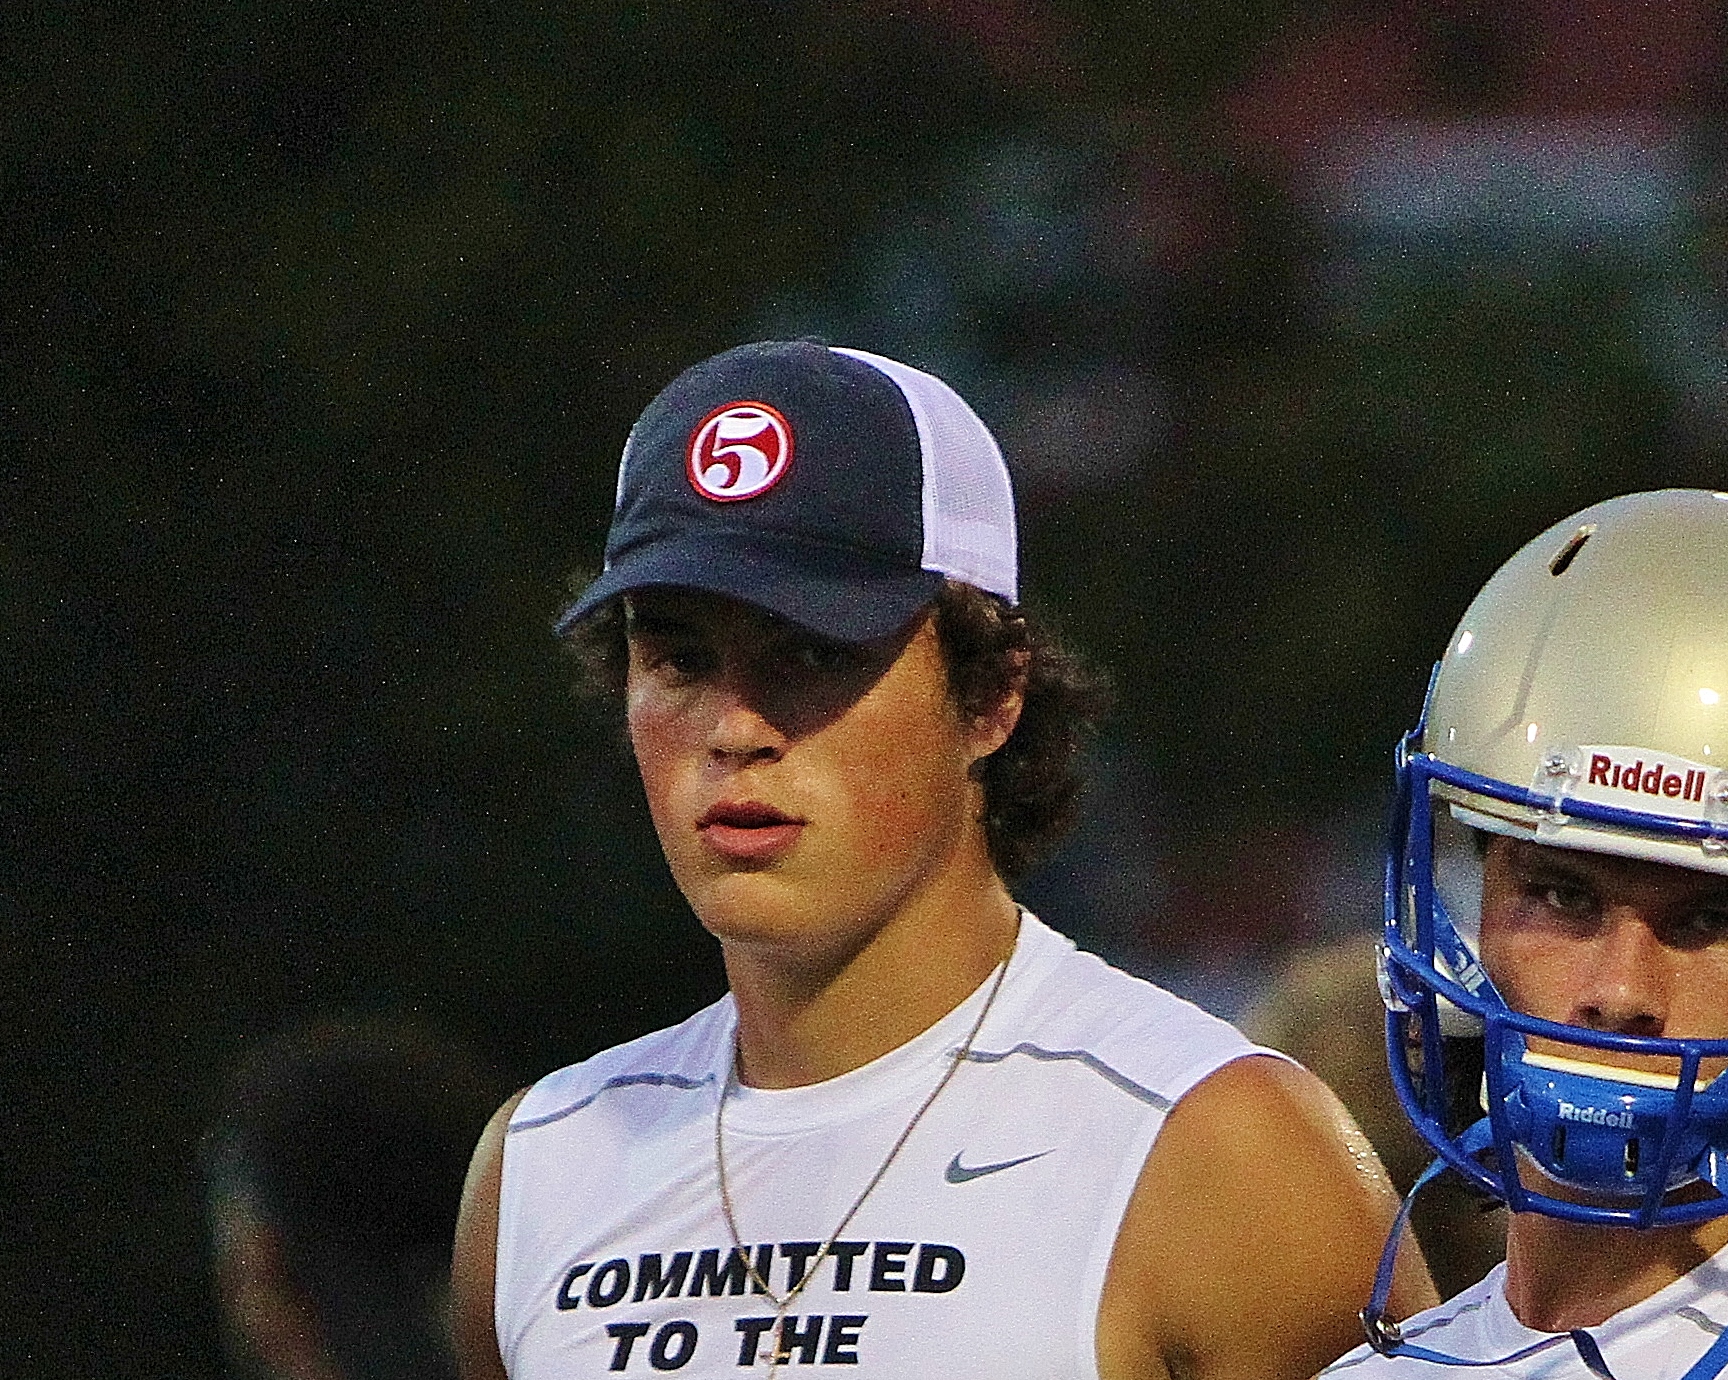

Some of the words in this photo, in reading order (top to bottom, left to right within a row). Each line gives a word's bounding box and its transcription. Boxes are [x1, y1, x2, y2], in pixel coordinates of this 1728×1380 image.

[703, 414, 771, 492] 5
[1588, 753, 1706, 802] Riddell
[1558, 1101, 1635, 1129] Riddell
[556, 1241, 966, 1310] COMMITTED
[605, 1320, 699, 1372] TO
[734, 1314, 868, 1367] THE
